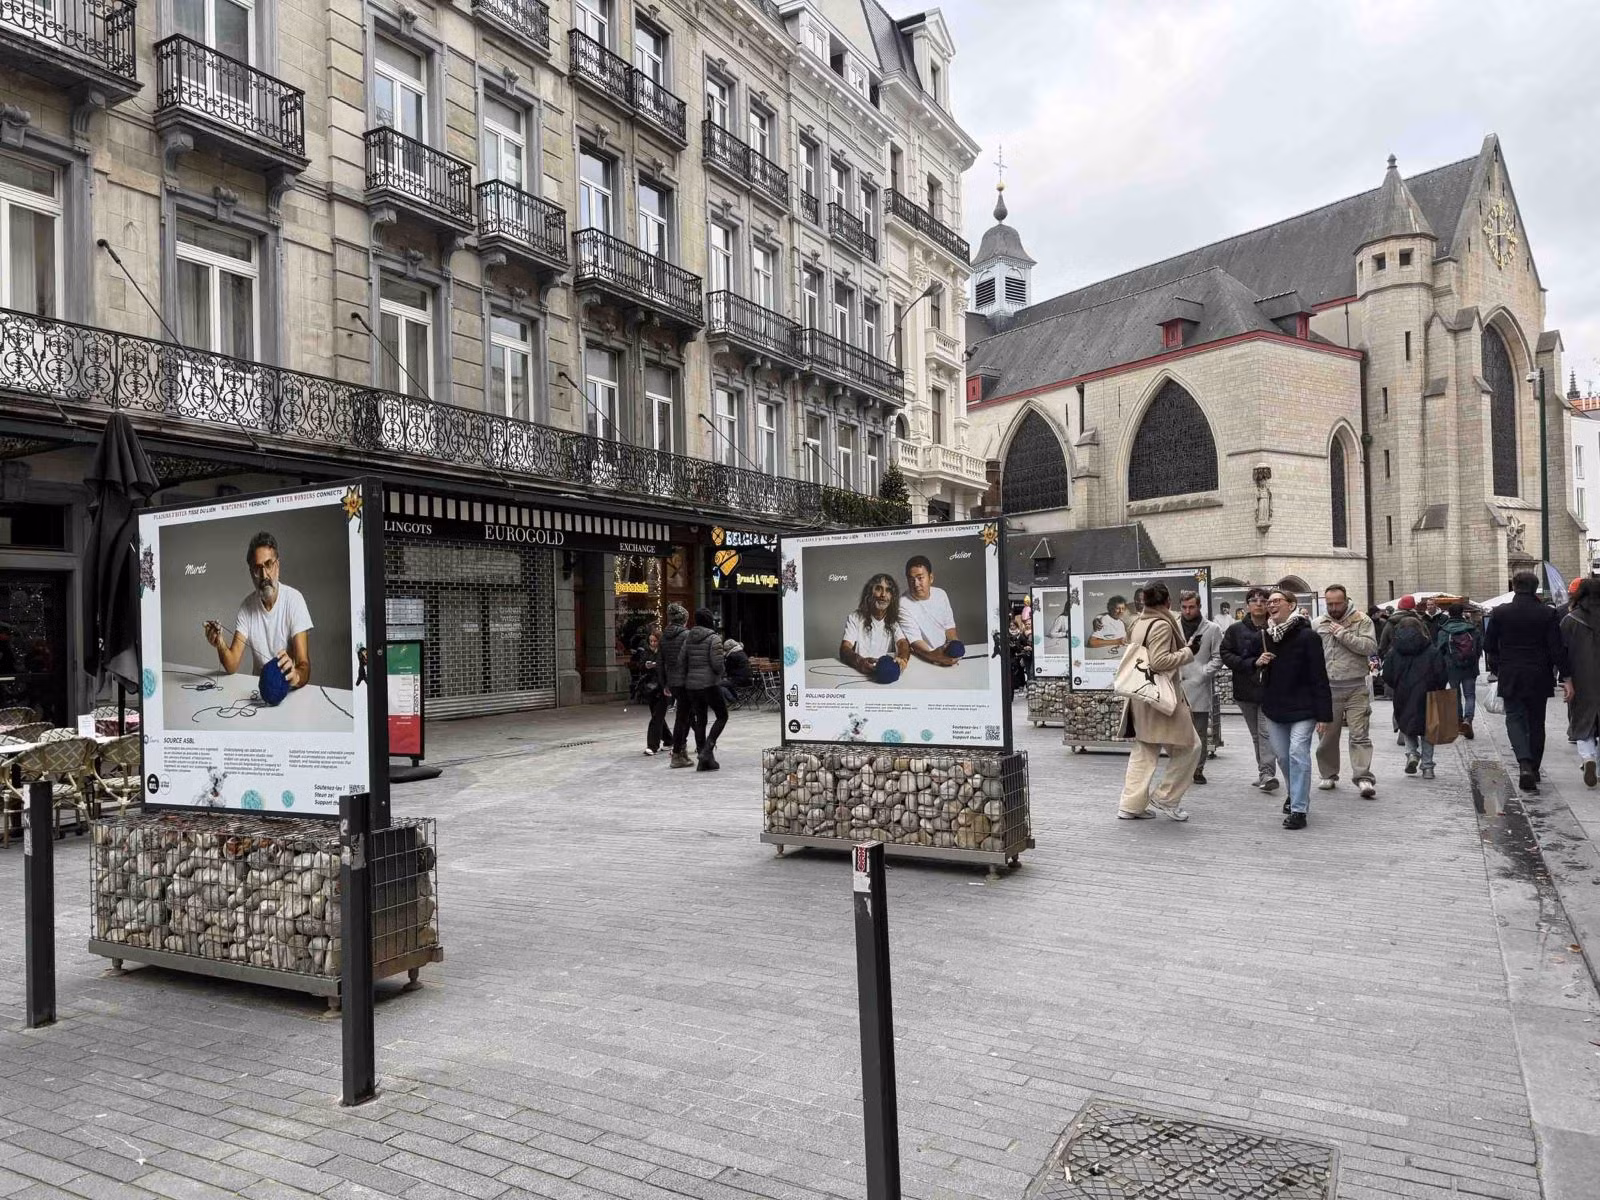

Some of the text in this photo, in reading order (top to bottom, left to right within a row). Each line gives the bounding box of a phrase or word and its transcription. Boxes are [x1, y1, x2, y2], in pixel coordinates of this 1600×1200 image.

[316, 489, 342, 498] CONNECTS
[384, 520, 433, 535] LINGOTS
[484, 525, 565, 546] EUROGOLD
[619, 542, 656, 554] EXCHANGE
[949, 551, 972, 560] Julien
[184, 562, 206, 576] Murat
[828, 574, 848, 582] Pierre
